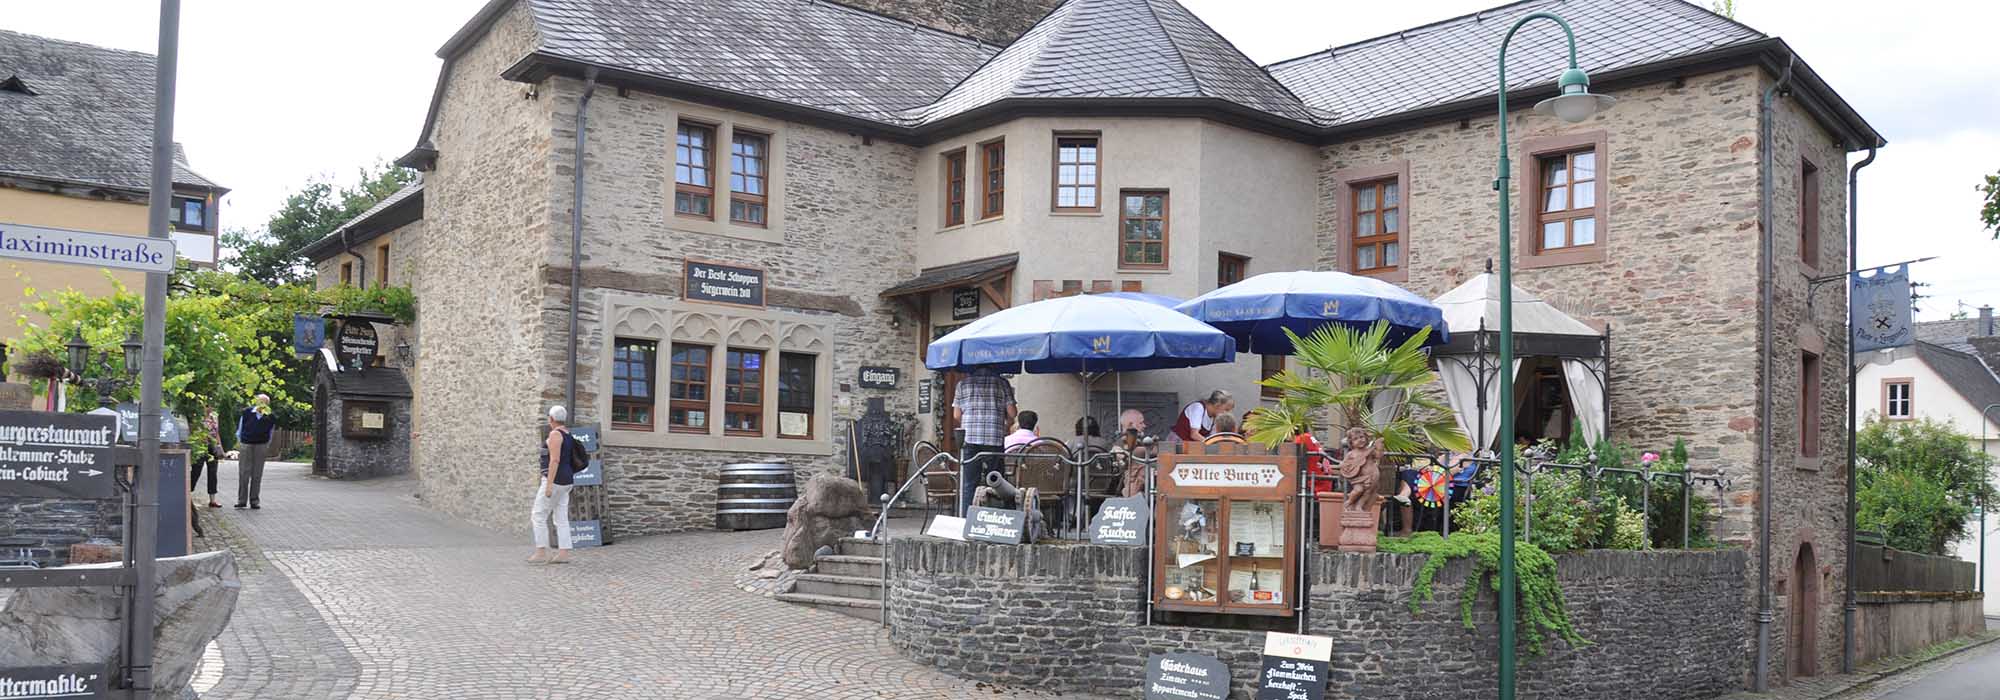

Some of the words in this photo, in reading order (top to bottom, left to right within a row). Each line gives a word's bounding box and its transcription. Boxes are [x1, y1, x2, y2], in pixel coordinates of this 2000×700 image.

[0, 231, 163, 264] aximinstraße
[693, 267, 706, 279] Der
[707, 268, 727, 281] Beste
[727, 271, 759, 285] Schoppen
[863, 369, 895, 386] Eingang
[0, 424, 112, 446] urgrestaurant
[0, 446, 95, 465] hlemmer-Stube
[0, 464, 69, 482] in-Cabinet
[1192, 468, 1219, 481] Alte
[1223, 468, 1260, 485] Burg
[977, 510, 1015, 525] Einkehr
[1102, 505, 1137, 520] Kaffee
[1097, 525, 1137, 539] Kuchen
[1160, 658, 1208, 677] Gästehaus
[1266, 667, 1318, 682] Flammkuchen
[1280, 660, 1296, 669] Zum
[1296, 662, 1314, 672] Wein
[0, 674, 97, 697] ttermahle"
[1160, 673, 1188, 685] Zimmer
[1151, 682, 1198, 699] Appartements
